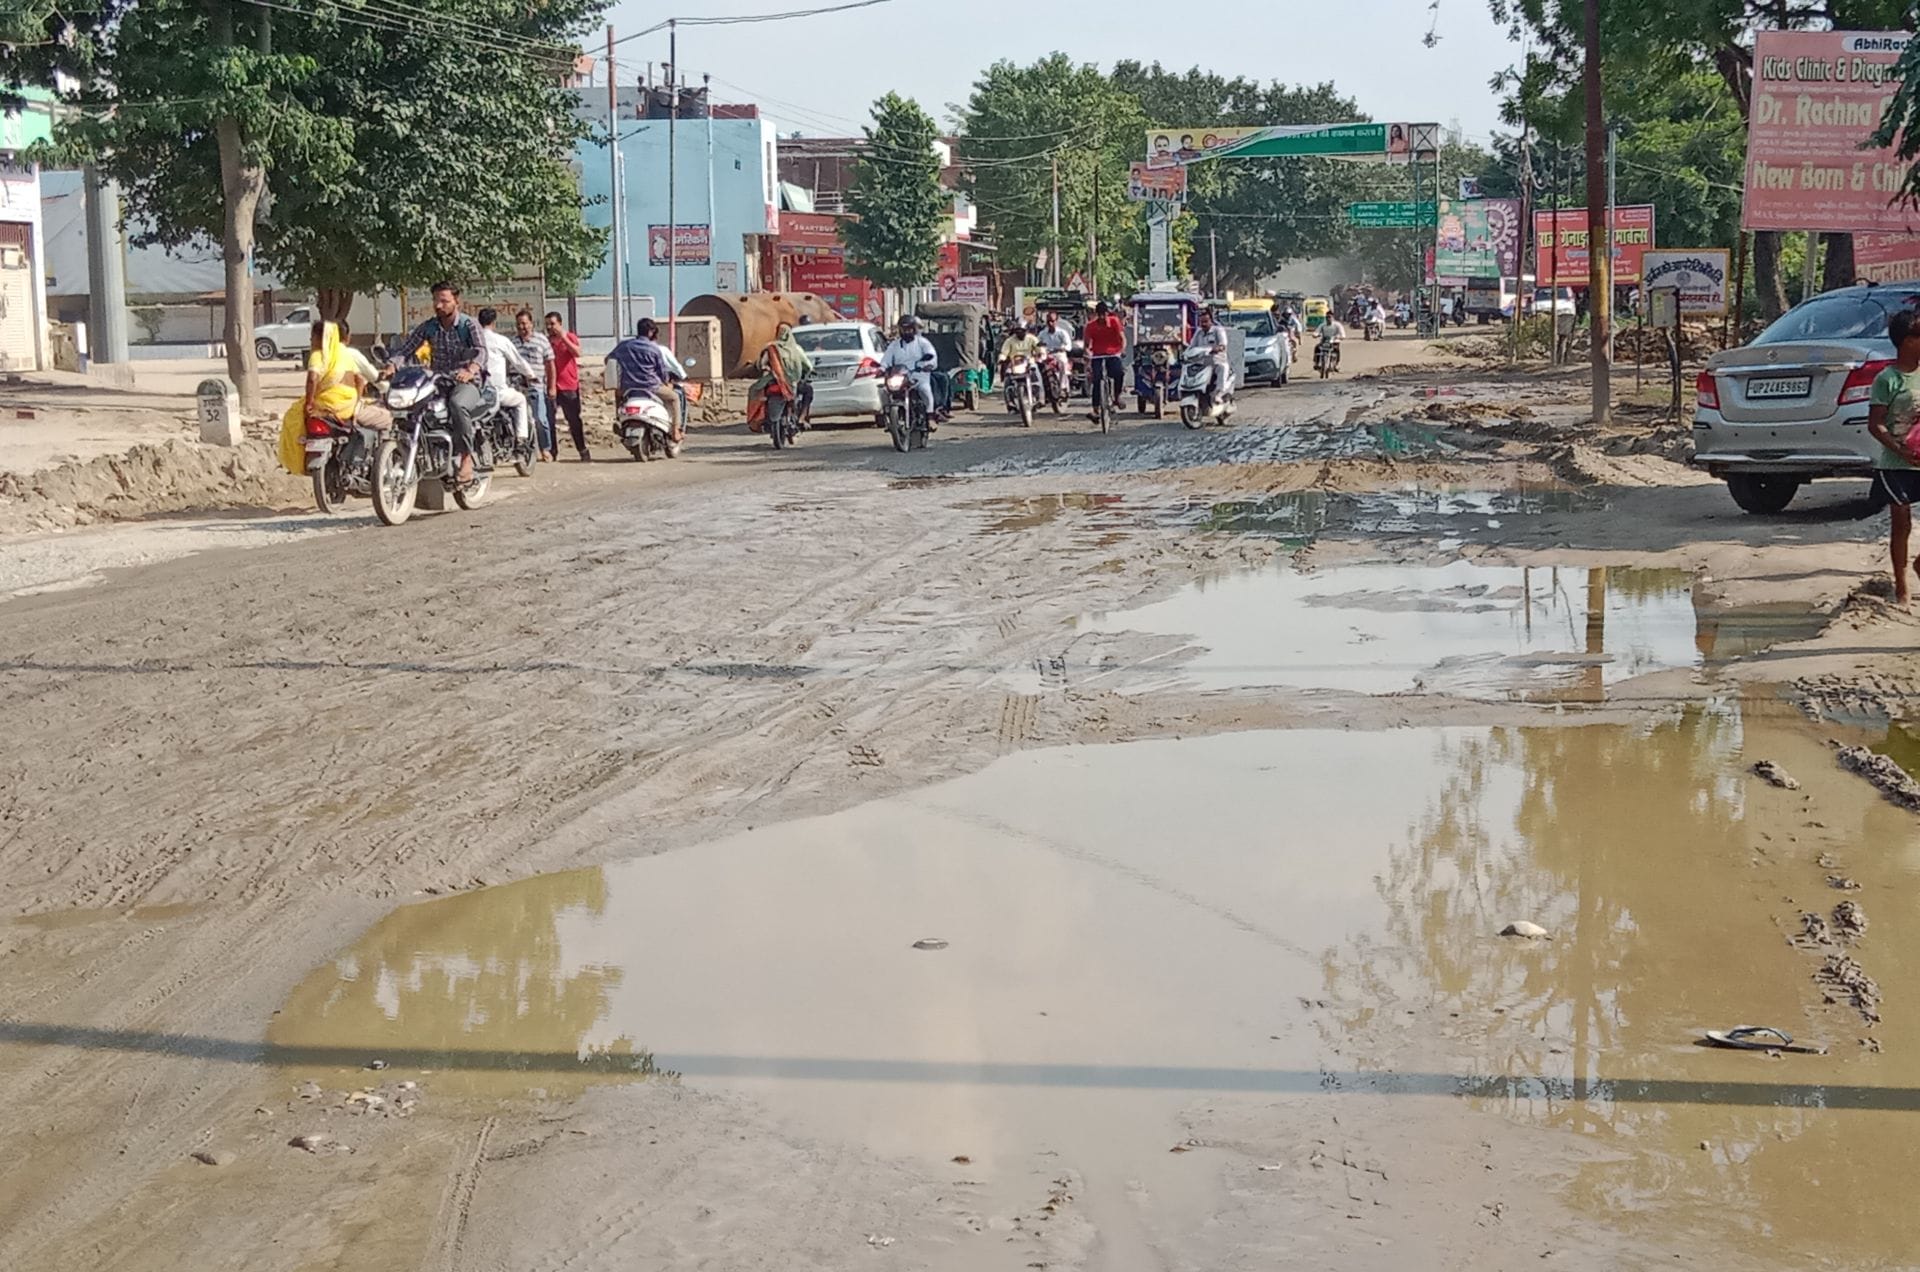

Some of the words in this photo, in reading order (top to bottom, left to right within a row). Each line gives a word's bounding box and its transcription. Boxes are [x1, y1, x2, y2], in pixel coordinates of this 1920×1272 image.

[1762, 56, 1791, 81] Kids
[1795, 57, 1832, 82] Clinic
[1835, 57, 1847, 82] &
[1757, 94, 1787, 125] Dr.
[1795, 94, 1873, 127] Rachna
[1753, 160, 1794, 189] New
[1801, 161, 1845, 191] Born
[1851, 162, 1866, 191] &
[205, 409, 221, 423] 32
